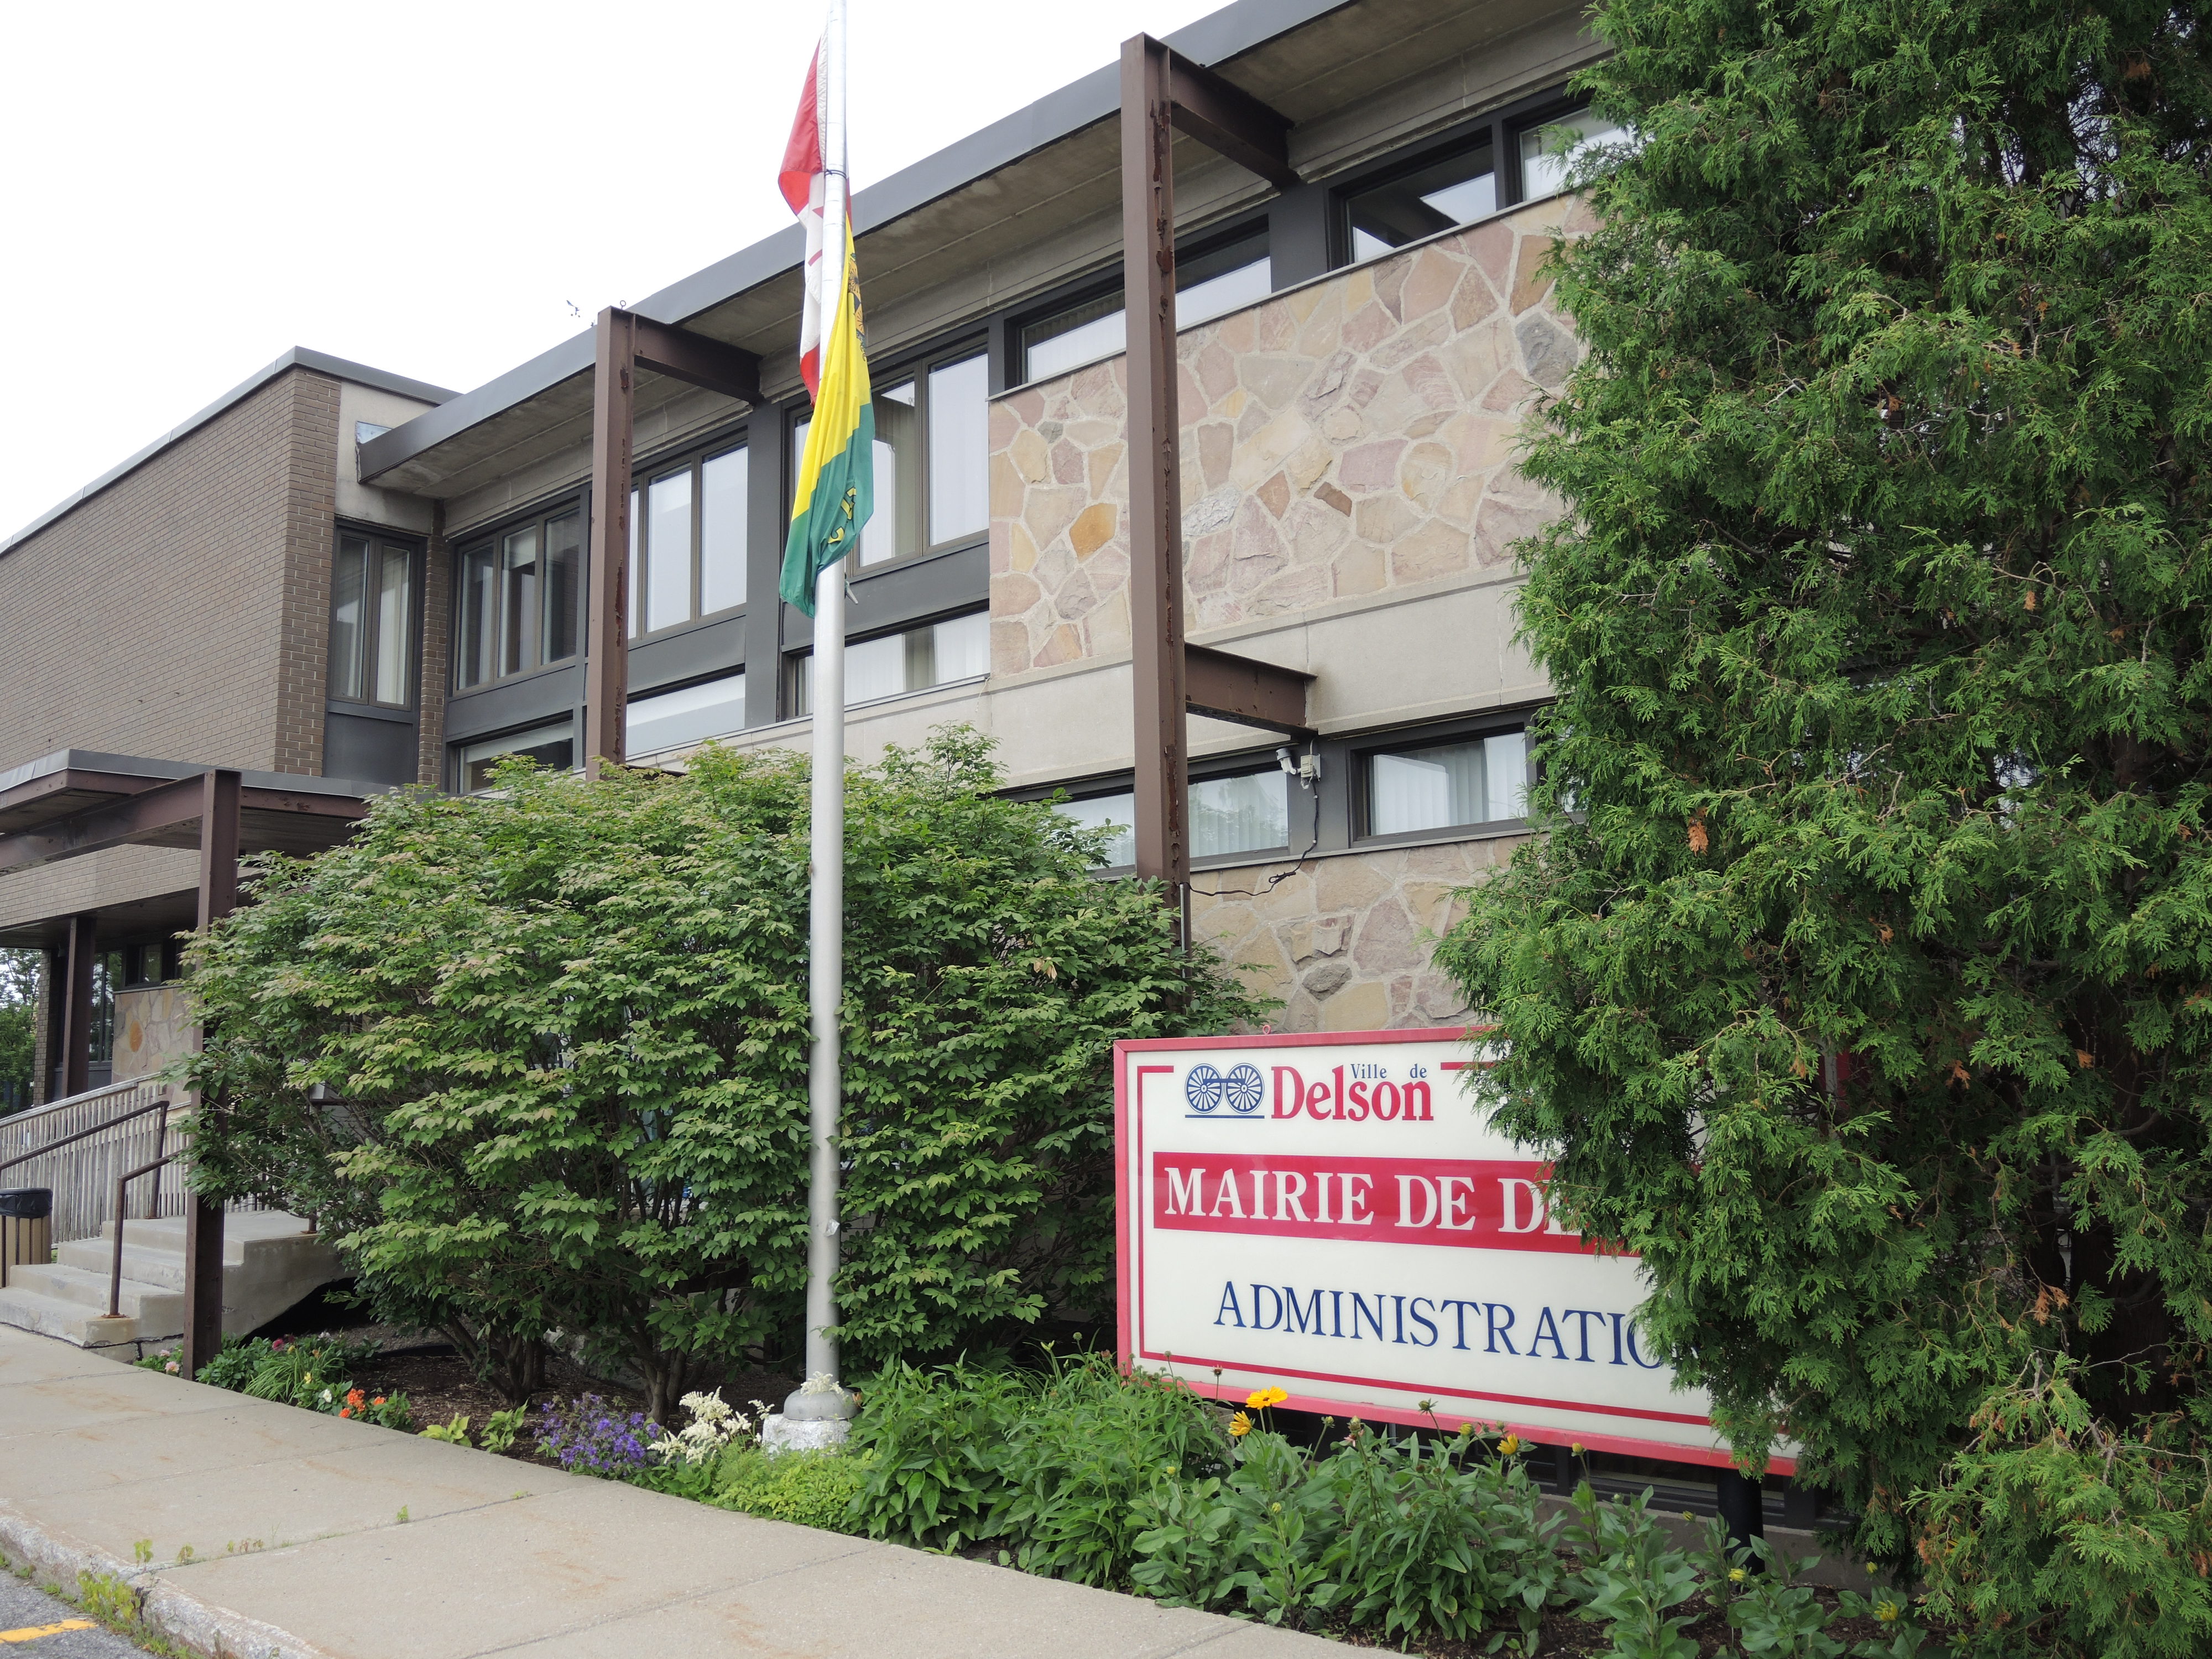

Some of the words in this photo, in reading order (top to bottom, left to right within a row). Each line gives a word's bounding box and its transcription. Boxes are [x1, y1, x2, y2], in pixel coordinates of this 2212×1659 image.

[1271, 1065, 1434, 1122] Delson
[1350, 1063, 1387, 1079] Ville
[1409, 1063, 1428, 1079] de
[1163, 1166, 1375, 1226] MAIRIE
[1394, 1173, 1476, 1232] DE
[1213, 1280, 1699, 1370] ADMINISTRATIO
